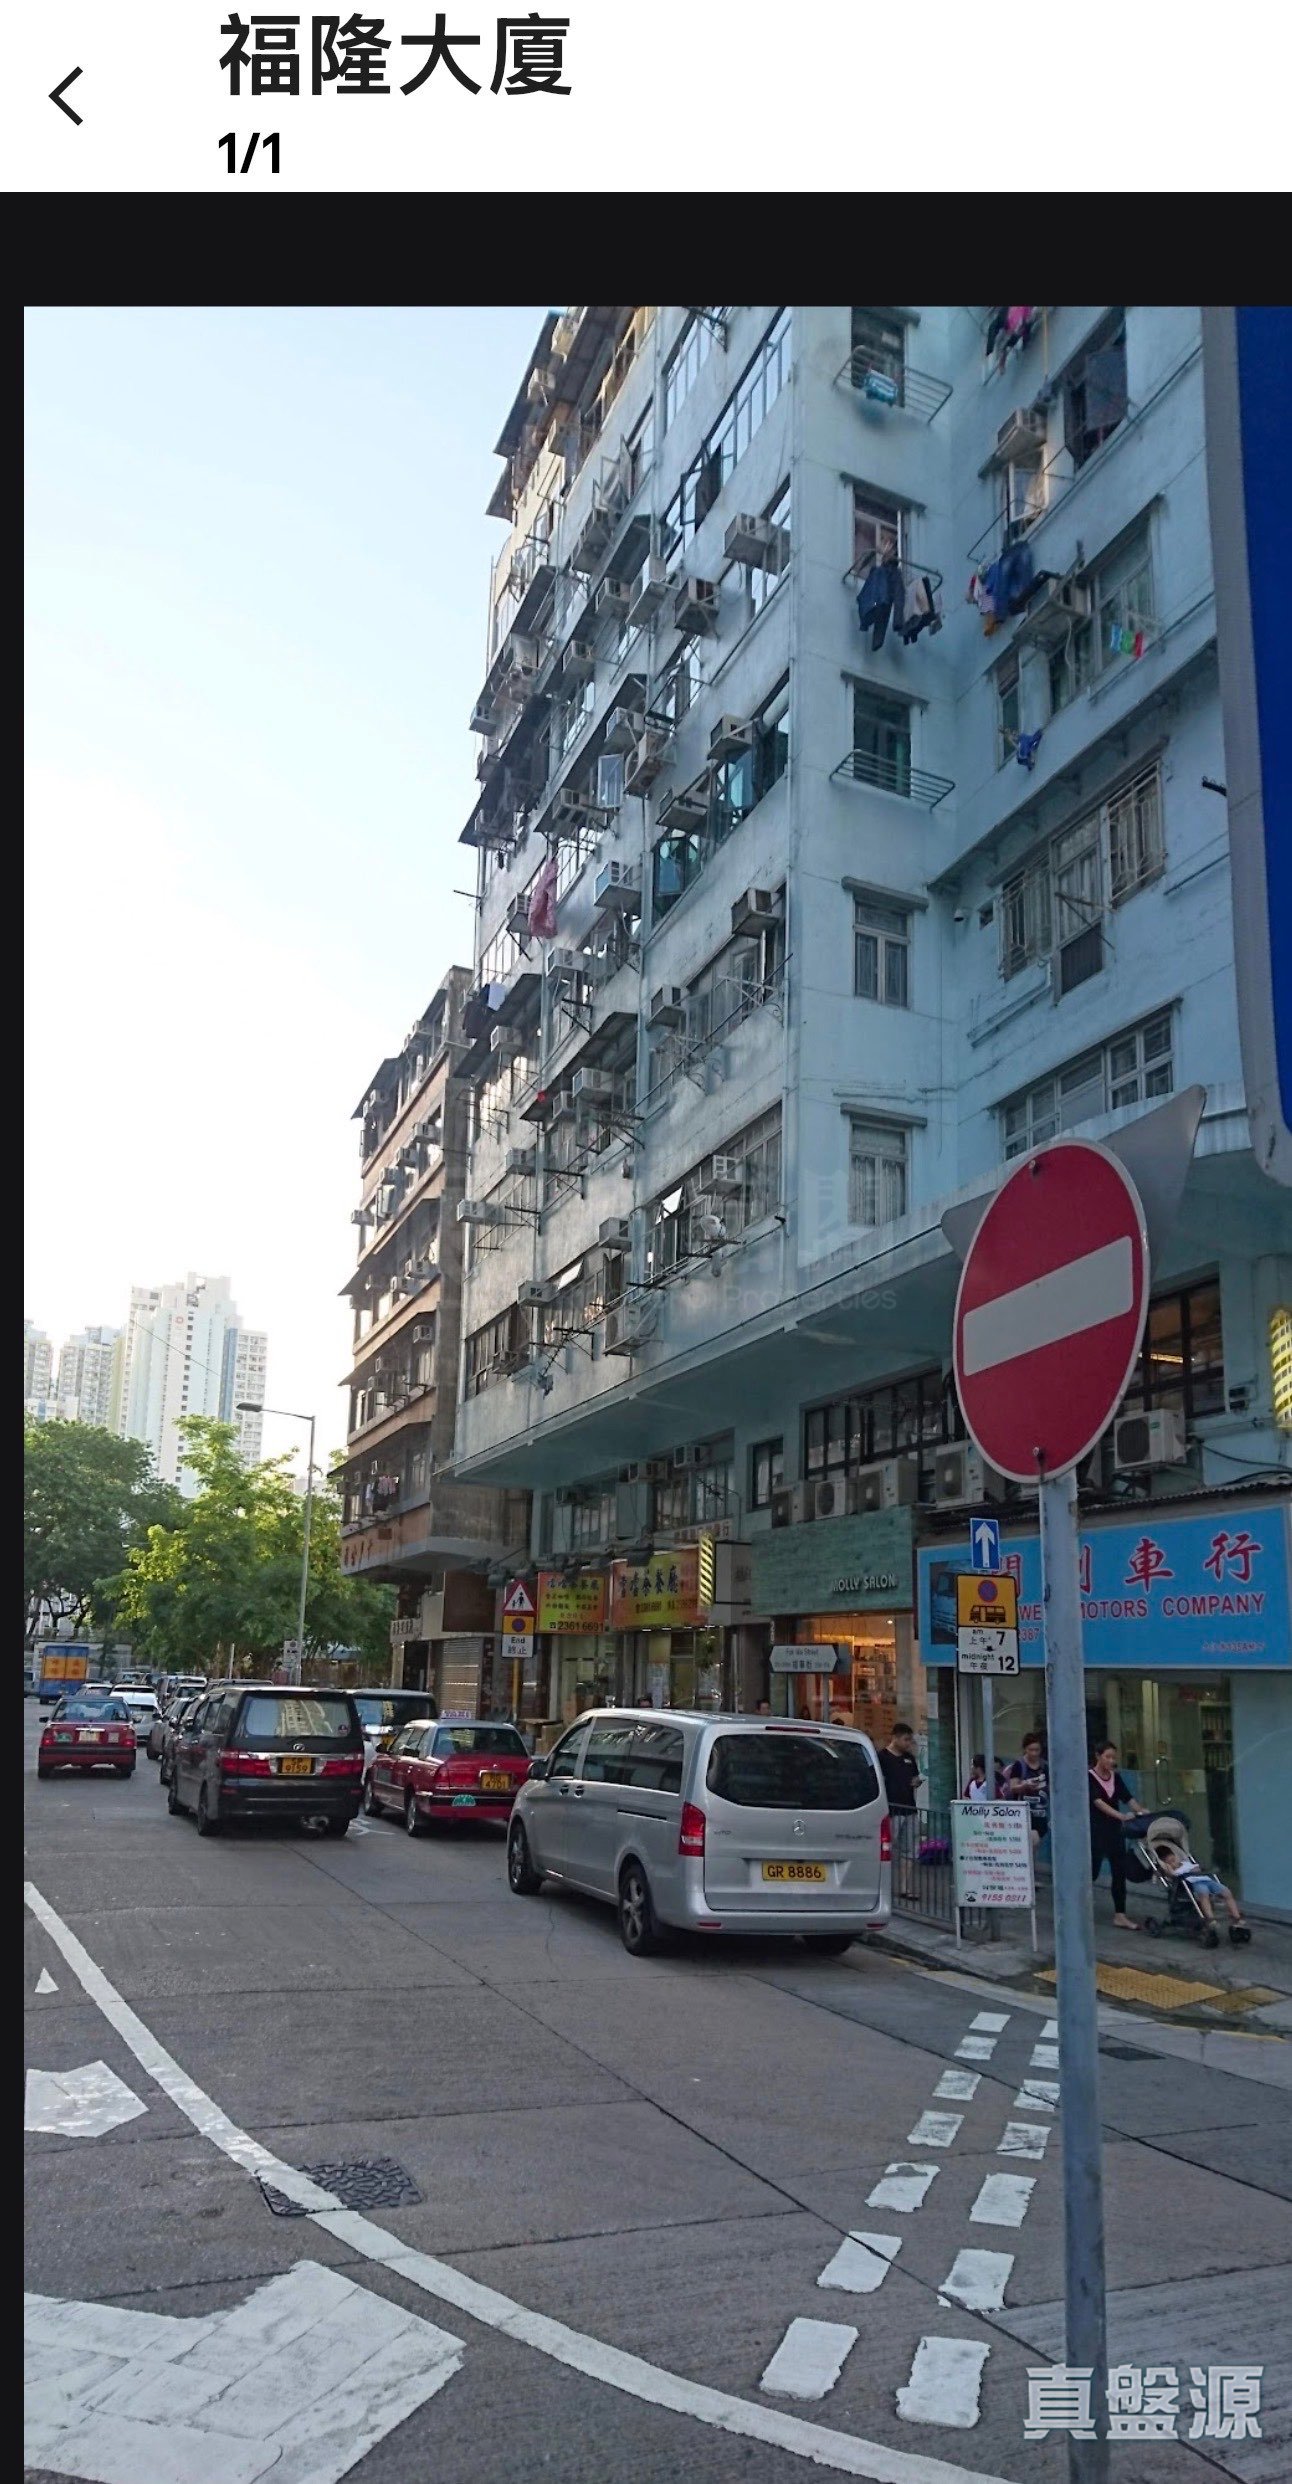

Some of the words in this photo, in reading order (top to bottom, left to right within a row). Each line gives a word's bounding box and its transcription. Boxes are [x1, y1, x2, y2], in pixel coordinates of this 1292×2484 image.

[863, 1573, 897, 1590] SALON
[1163, 1593, 1266, 1617] COMPANY
[511, 1636, 525, 1644] End
[968, 1637, 987, 1645] 上午
[996, 1631, 1005, 1646] 7
[961, 1653, 995, 1662] midnight
[998, 1655, 1015, 1672] 12
[961, 1807, 990, 1818] Molly
[992, 1807, 1021, 1817] Salon
[767, 1865, 784, 1878] GR
[788, 1865, 822, 1878] 8886
